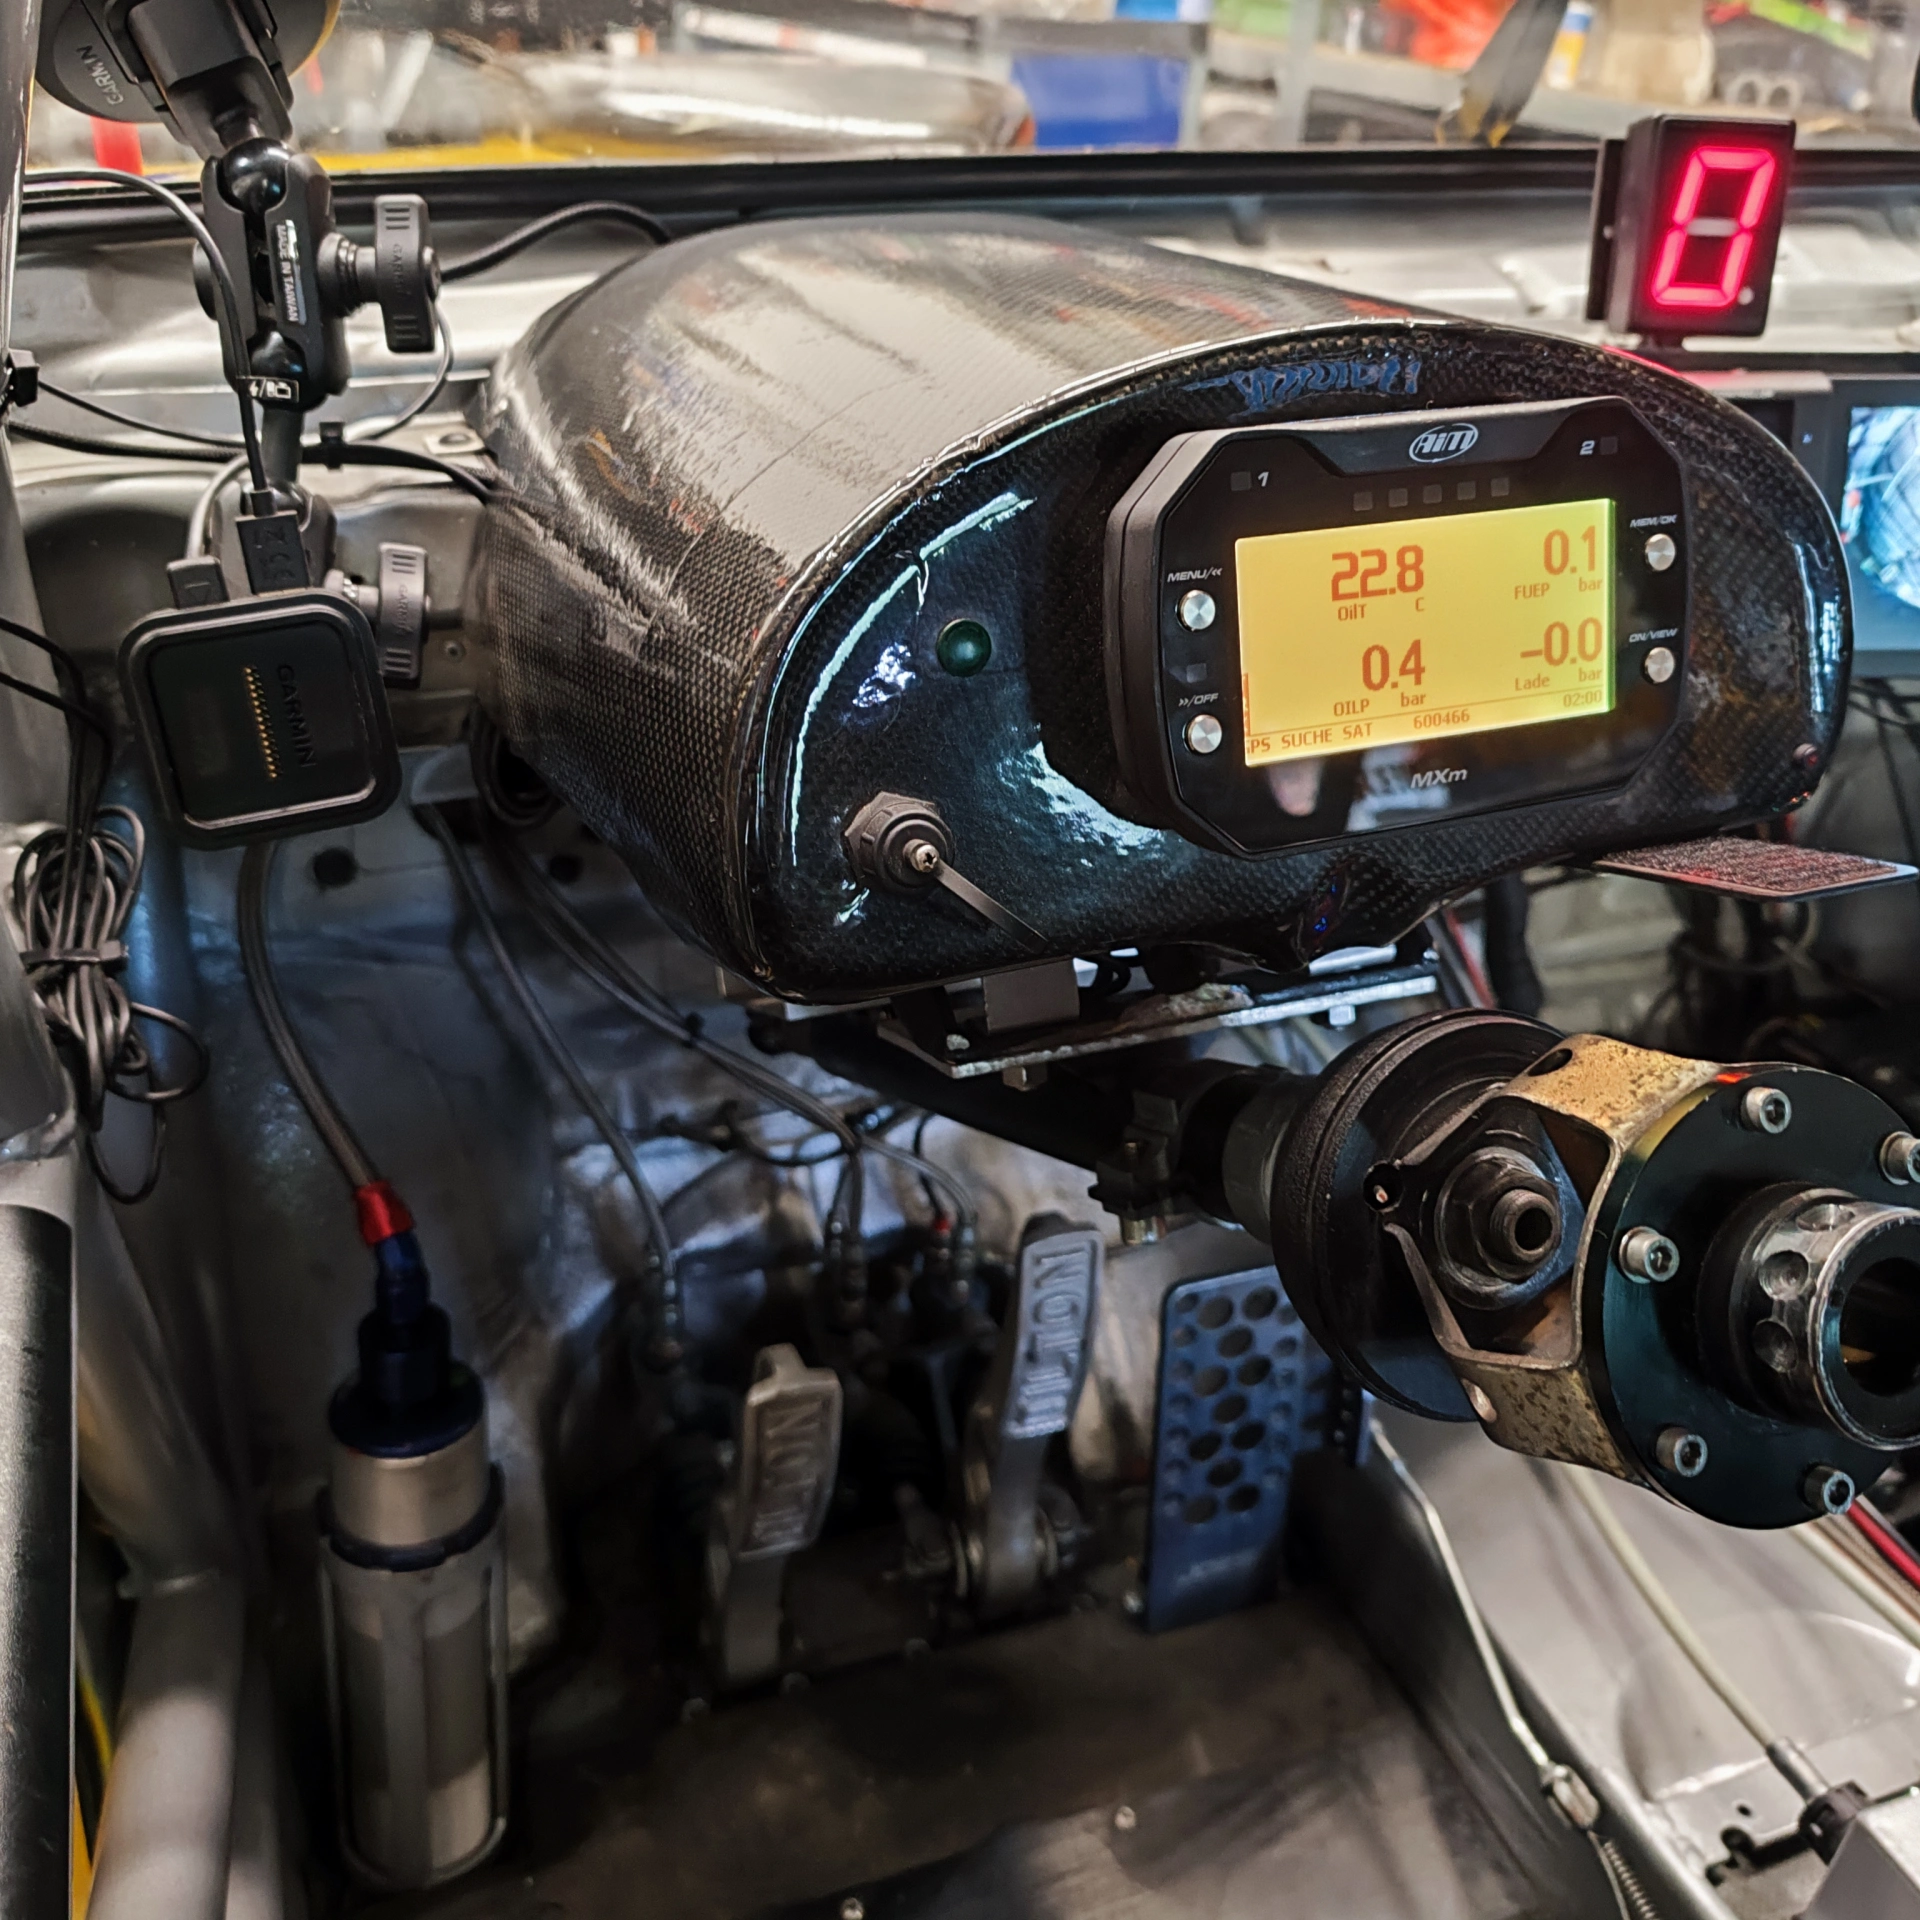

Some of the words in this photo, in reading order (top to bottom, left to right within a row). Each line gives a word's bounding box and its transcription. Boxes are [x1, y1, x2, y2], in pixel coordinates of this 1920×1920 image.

[76, 44, 124, 105] GARMIN
[275, 223, 288, 260] MADE
[1651, 145, 1775, 307] 0
[280, 260, 292, 275] IN
[283, 275, 299, 323] TAIWAN
[1579, 440, 1596, 456] 2
[1257, 471, 1270, 487] 1
[1629, 514, 1678, 528] MEM/OK
[1543, 525, 1596, 576] 0.1
[1331, 545, 1424, 602] 22.8
[1514, 582, 1550, 600] FUEP
[1579, 576, 1603, 592] bar
[1415, 597, 1425, 612] C
[1520, 617, 1603, 667] -0.0
[1629, 628, 1678, 643] ON/VIEW
[1362, 638, 1426, 691] 0.4
[1515, 673, 1550, 691] Lade
[1579, 667, 1603, 682] bar
[277, 663, 318, 768] GARMIN
[1281, 728, 1333, 750] SUCHE
[1342, 722, 1373, 740] SAT
[1413, 709, 1471, 730] 600466
[1563, 689, 1603, 708] 02:00
[1333, 698, 1370, 717] OILP
[1401, 692, 1426, 708] bar
[1410, 767, 1468, 789] MXm
